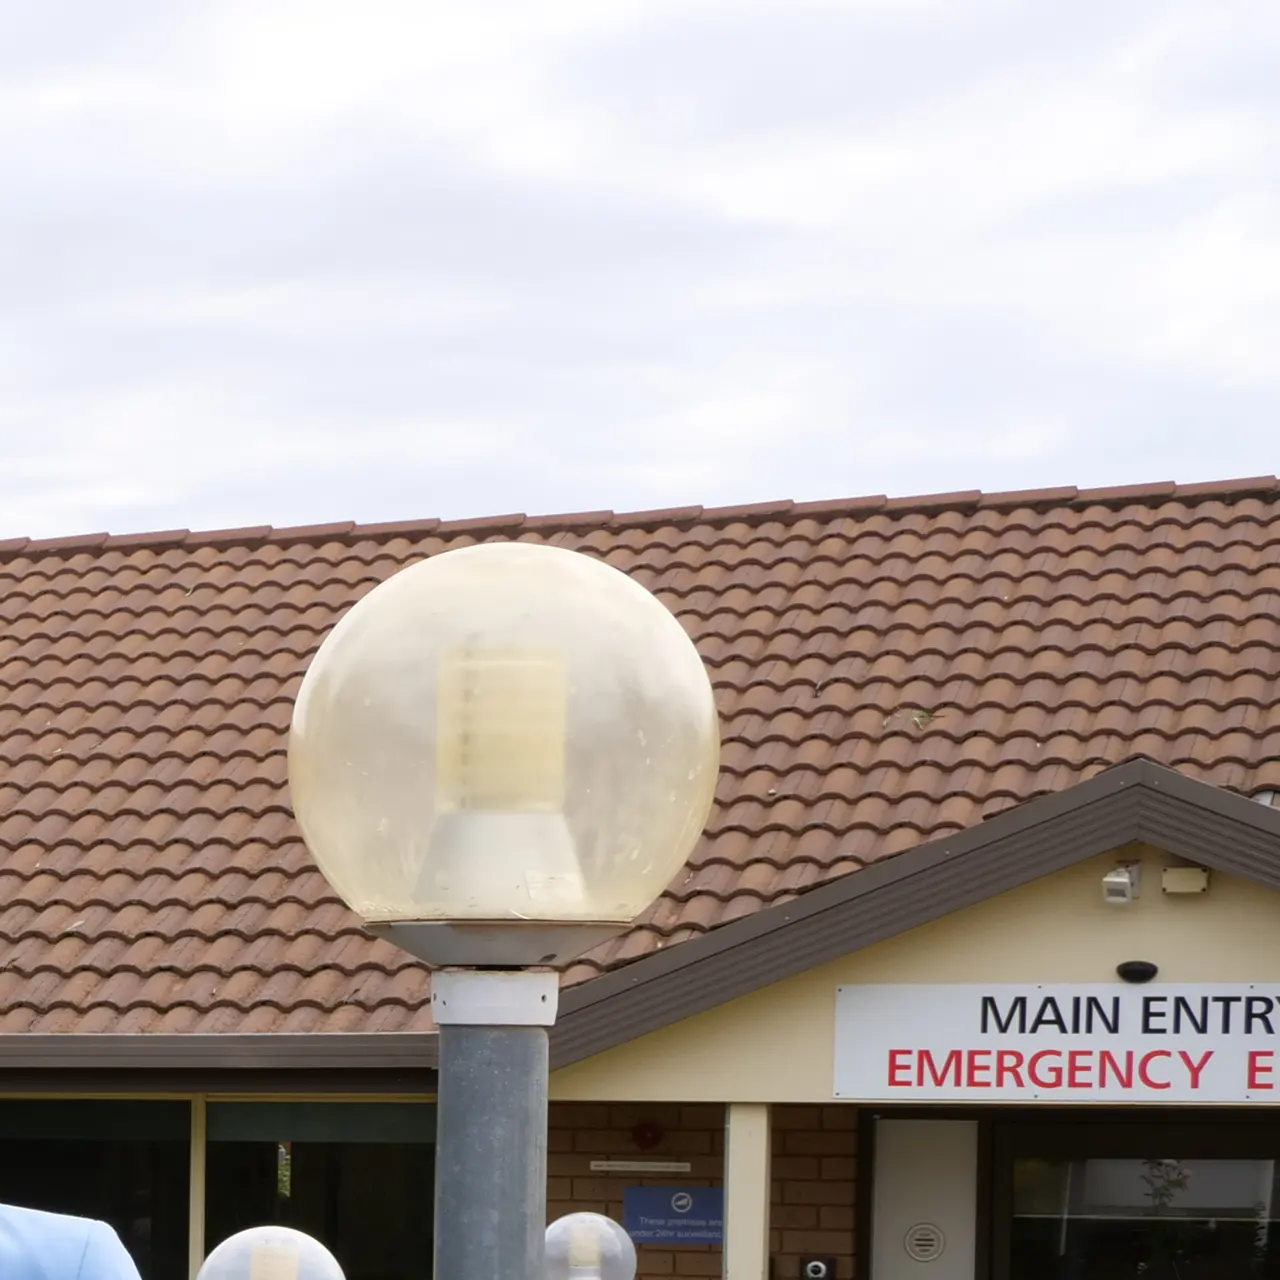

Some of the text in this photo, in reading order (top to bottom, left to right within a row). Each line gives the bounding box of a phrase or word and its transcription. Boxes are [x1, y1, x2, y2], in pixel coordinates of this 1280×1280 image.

[981, 996, 1280, 1034] MAIN ENTR
[888, 1049, 1280, 1089] EMERGENCY E
